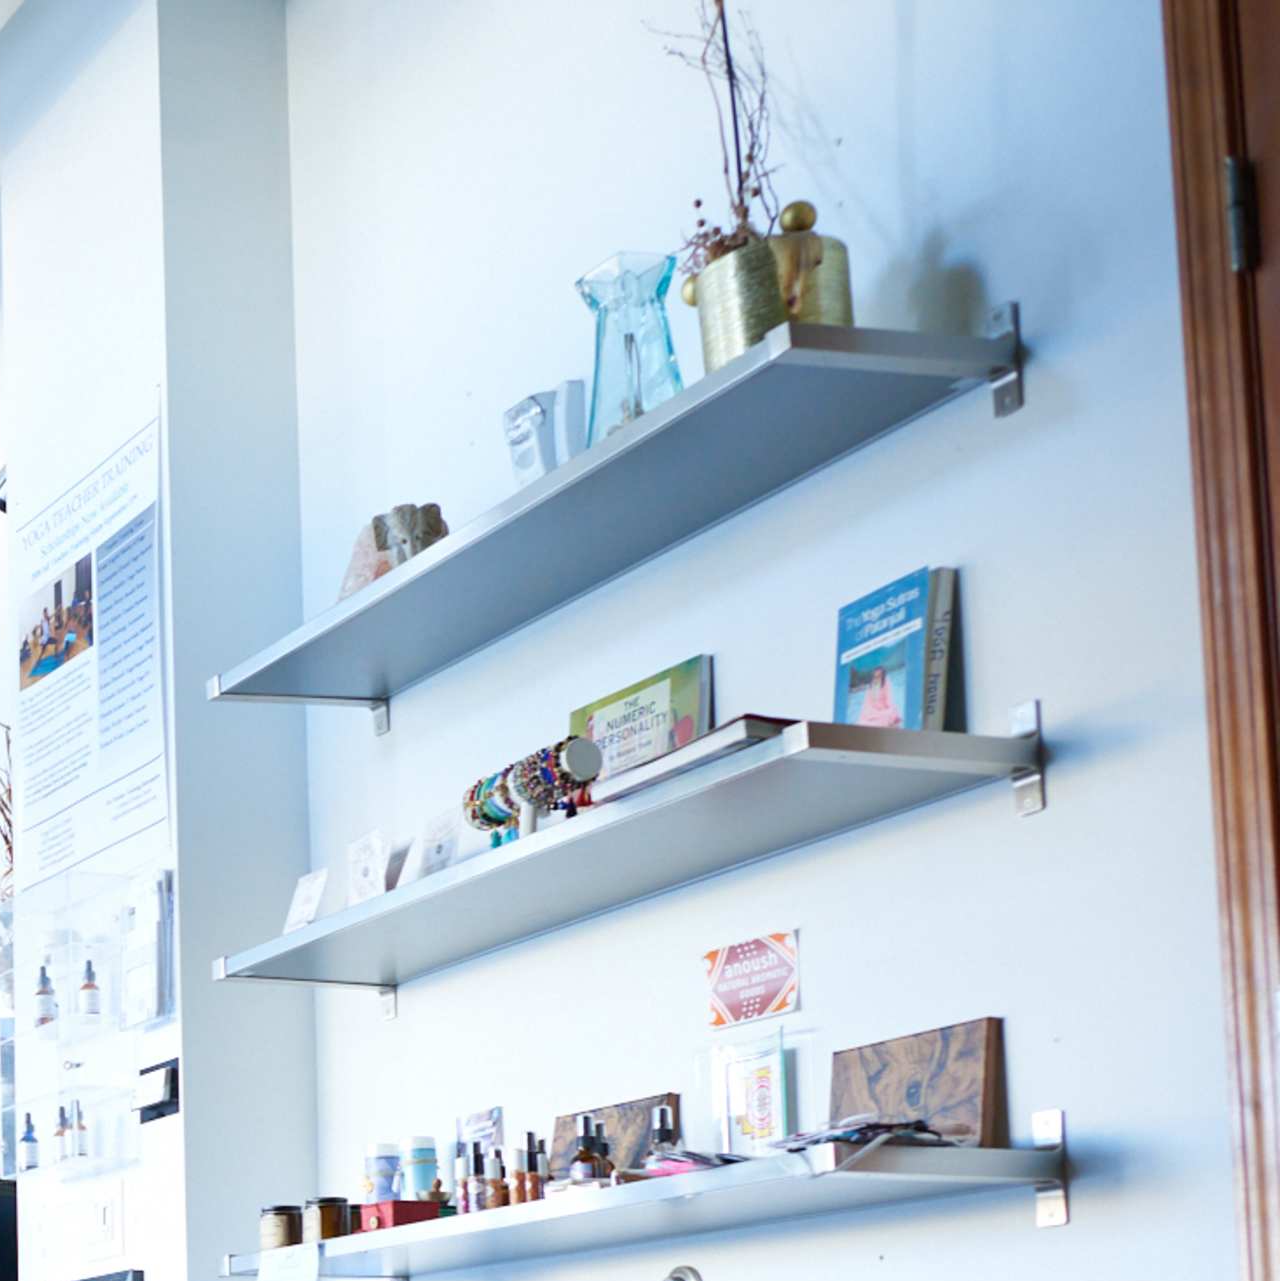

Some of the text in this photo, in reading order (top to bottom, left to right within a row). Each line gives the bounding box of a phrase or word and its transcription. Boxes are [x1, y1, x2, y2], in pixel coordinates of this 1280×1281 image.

[22, 519, 51, 552] YOGA
[52, 480, 100, 529] TEACHER
[100, 433, 153, 489] TRAINING
[861, 602, 887, 624] Yoga
[886, 587, 920, 609] Sutras
[605, 701, 657, 732] NUMERIC
[623, 695, 641, 711] THE
[724, 950, 778, 977] anoush
